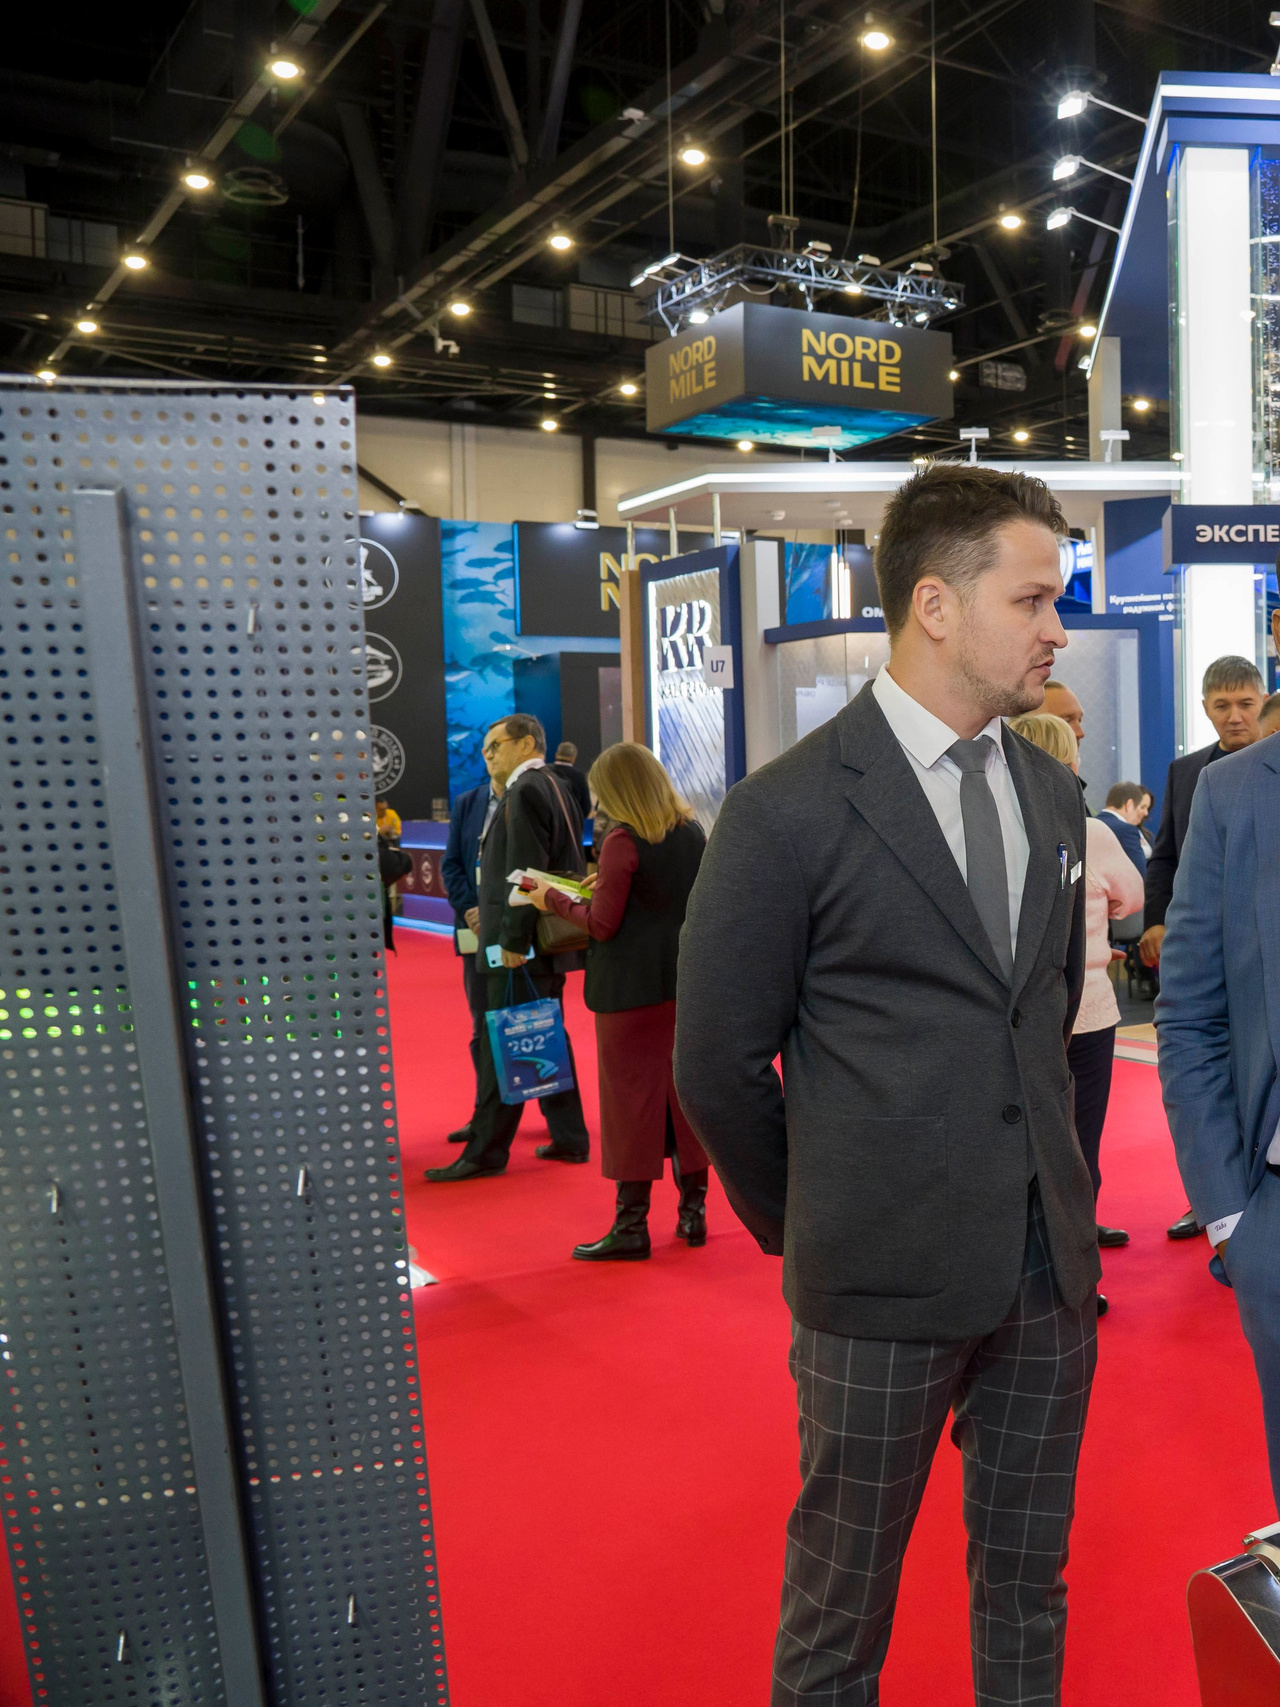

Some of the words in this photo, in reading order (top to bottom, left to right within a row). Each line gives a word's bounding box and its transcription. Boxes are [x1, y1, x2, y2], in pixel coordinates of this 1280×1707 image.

[669, 335, 716, 376] NORD
[802, 328, 901, 364] NORD
[669, 361, 717, 404] MILE
[802, 355, 901, 393] MILE
[710, 660, 726, 673] U7
